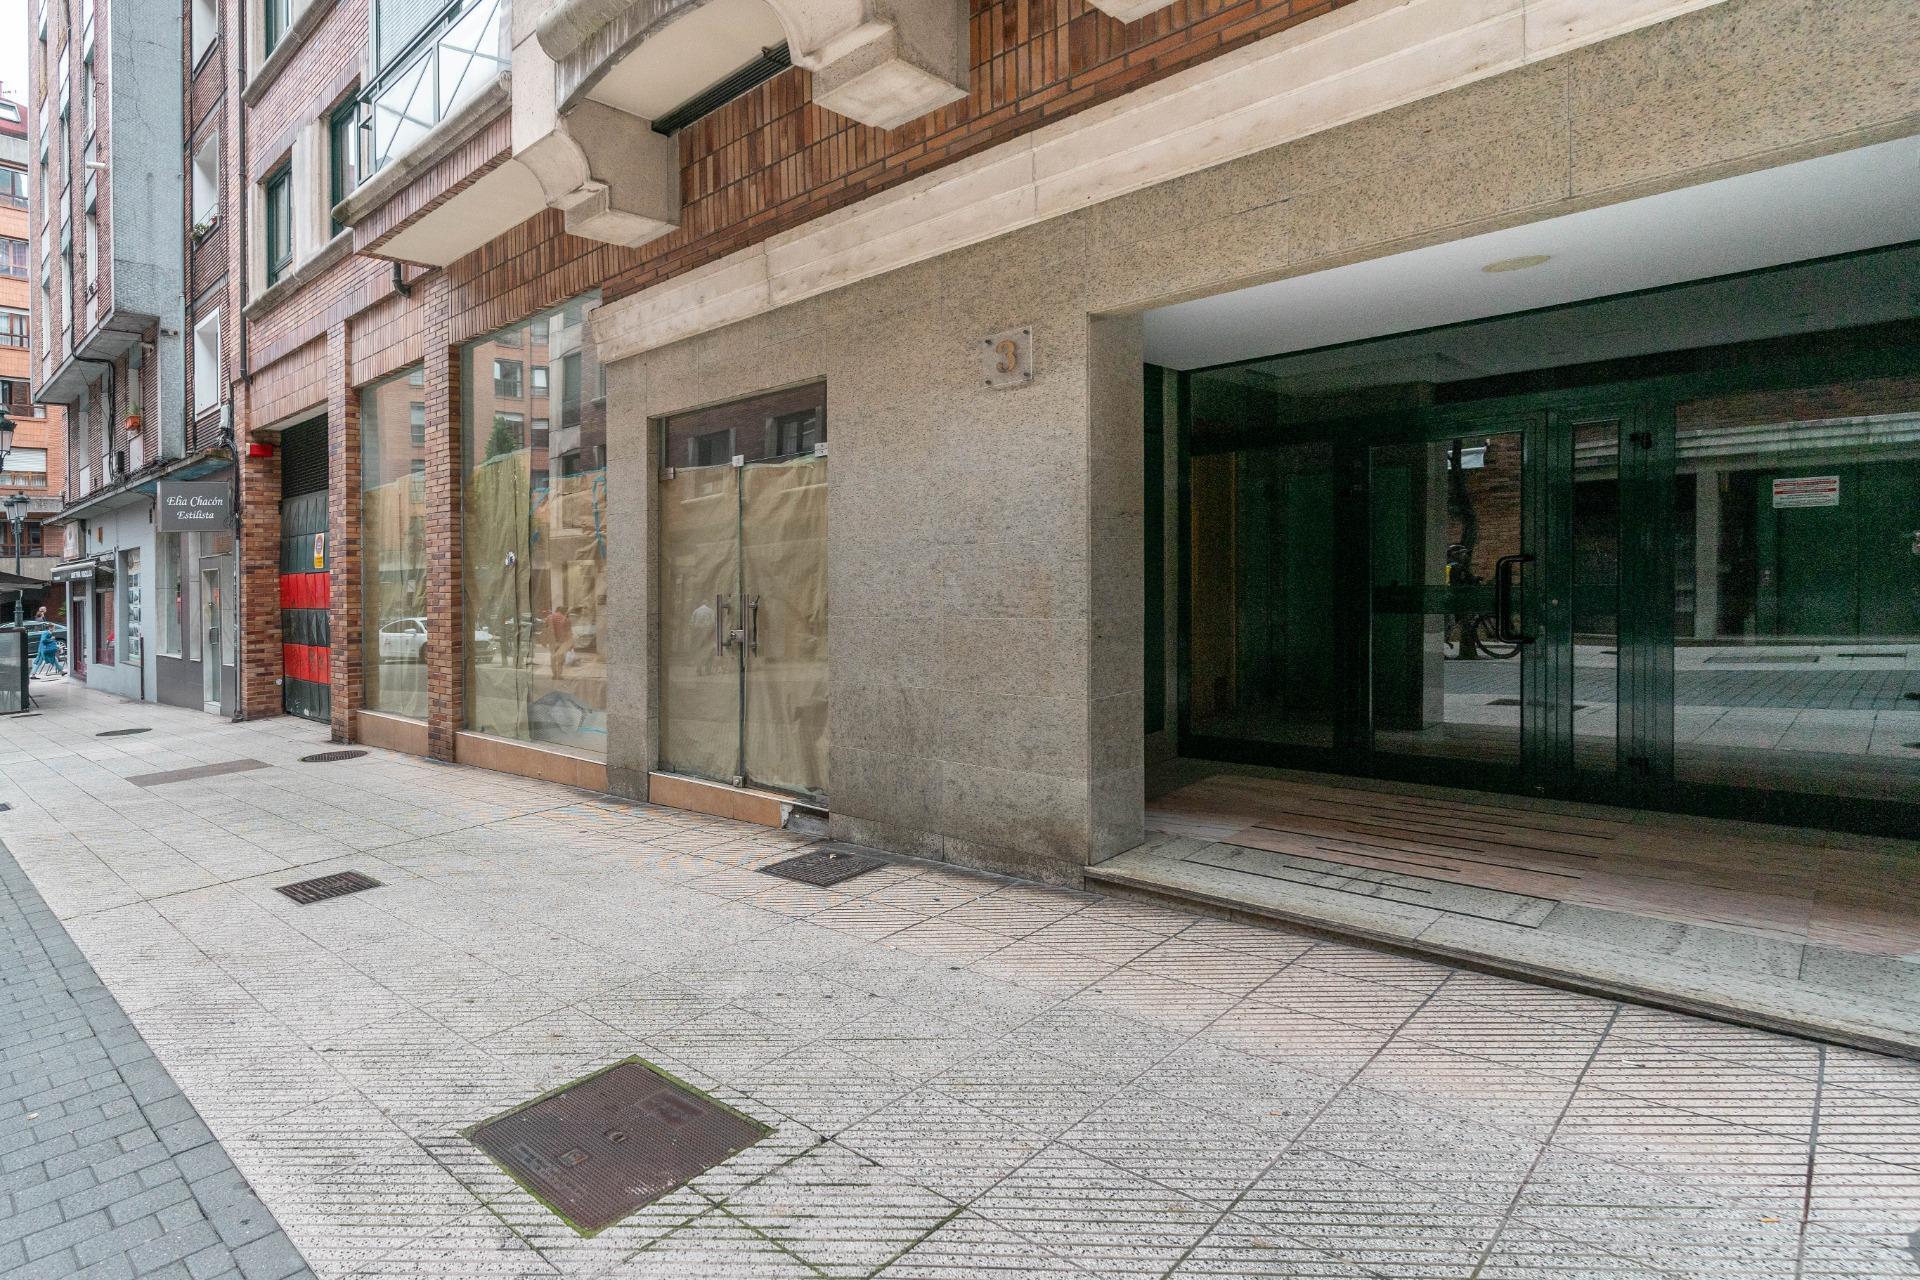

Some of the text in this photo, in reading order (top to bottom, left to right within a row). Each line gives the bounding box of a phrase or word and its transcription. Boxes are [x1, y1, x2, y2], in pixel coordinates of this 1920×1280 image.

[996, 339, 1016, 373] 3
[167, 496, 223, 507] Elia Chacón
[177, 510, 214, 519] Estilista
